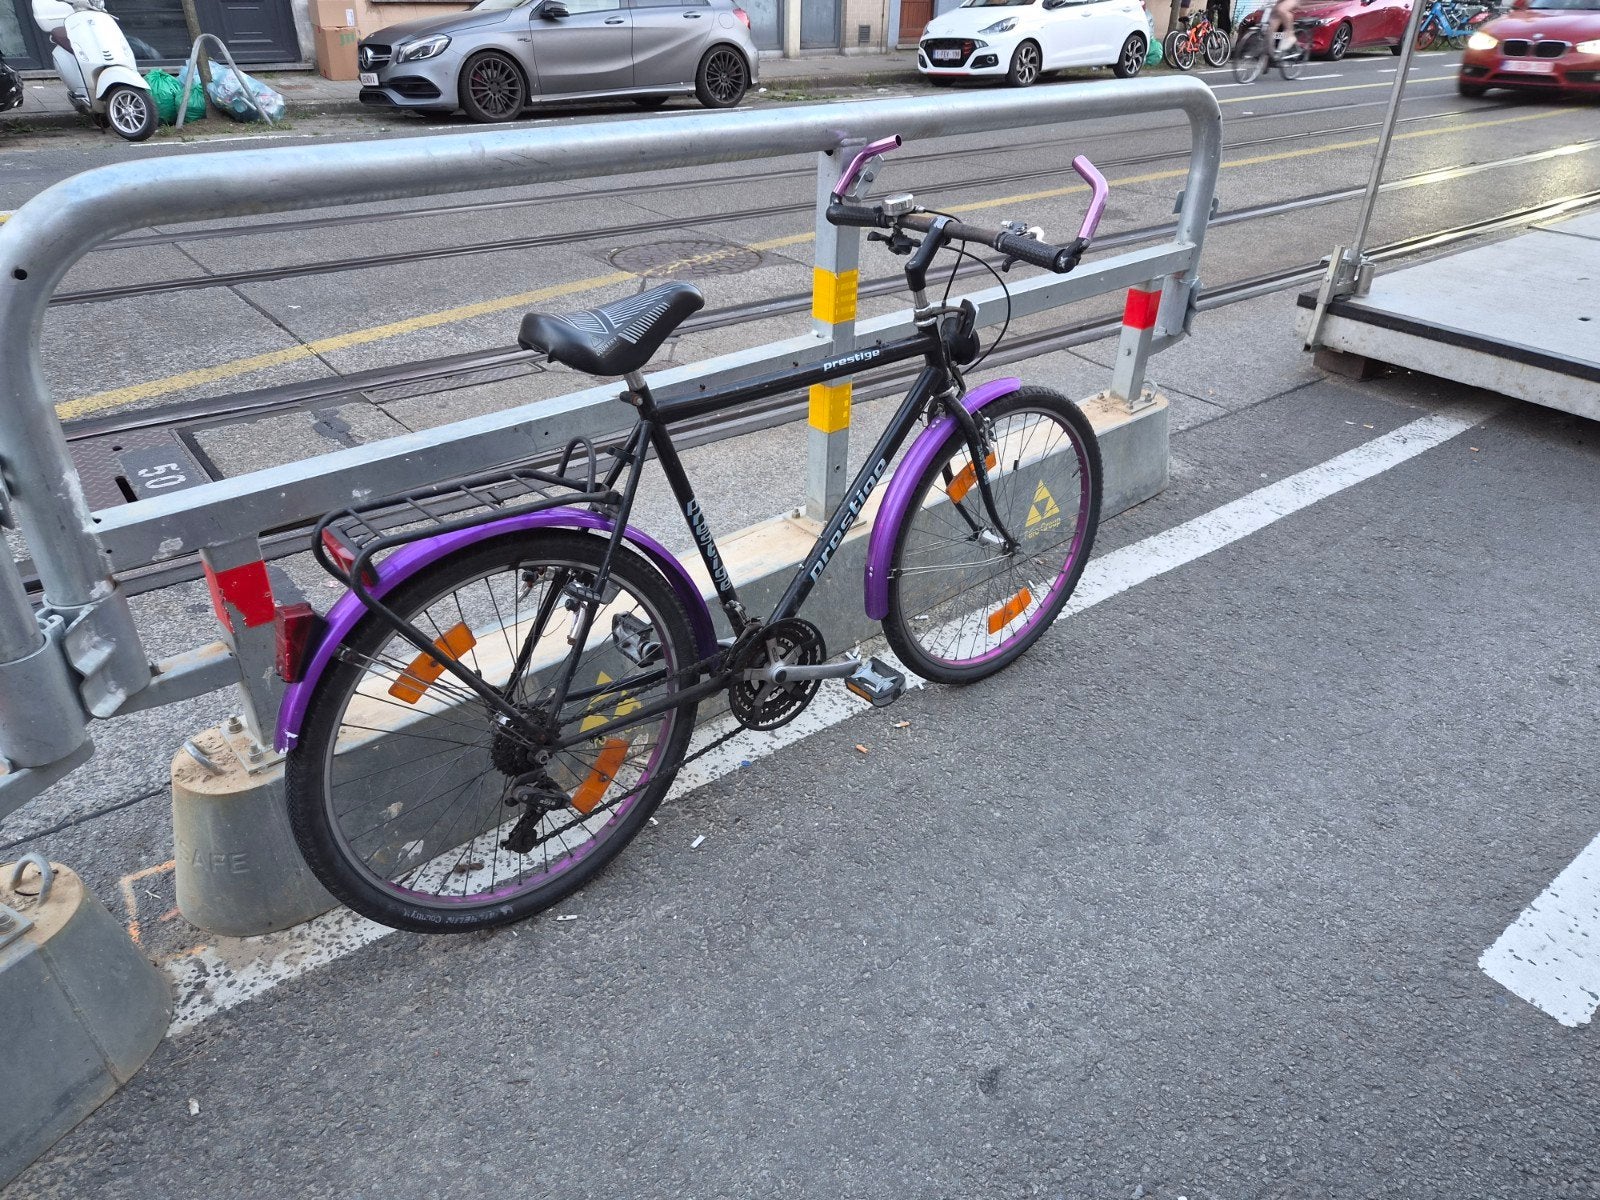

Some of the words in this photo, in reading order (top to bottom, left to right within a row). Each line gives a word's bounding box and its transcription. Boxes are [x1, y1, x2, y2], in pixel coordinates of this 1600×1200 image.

[823, 349, 880, 372] prestige
[138, 462, 187, 489] 50
[686, 499, 733, 592] prestige
